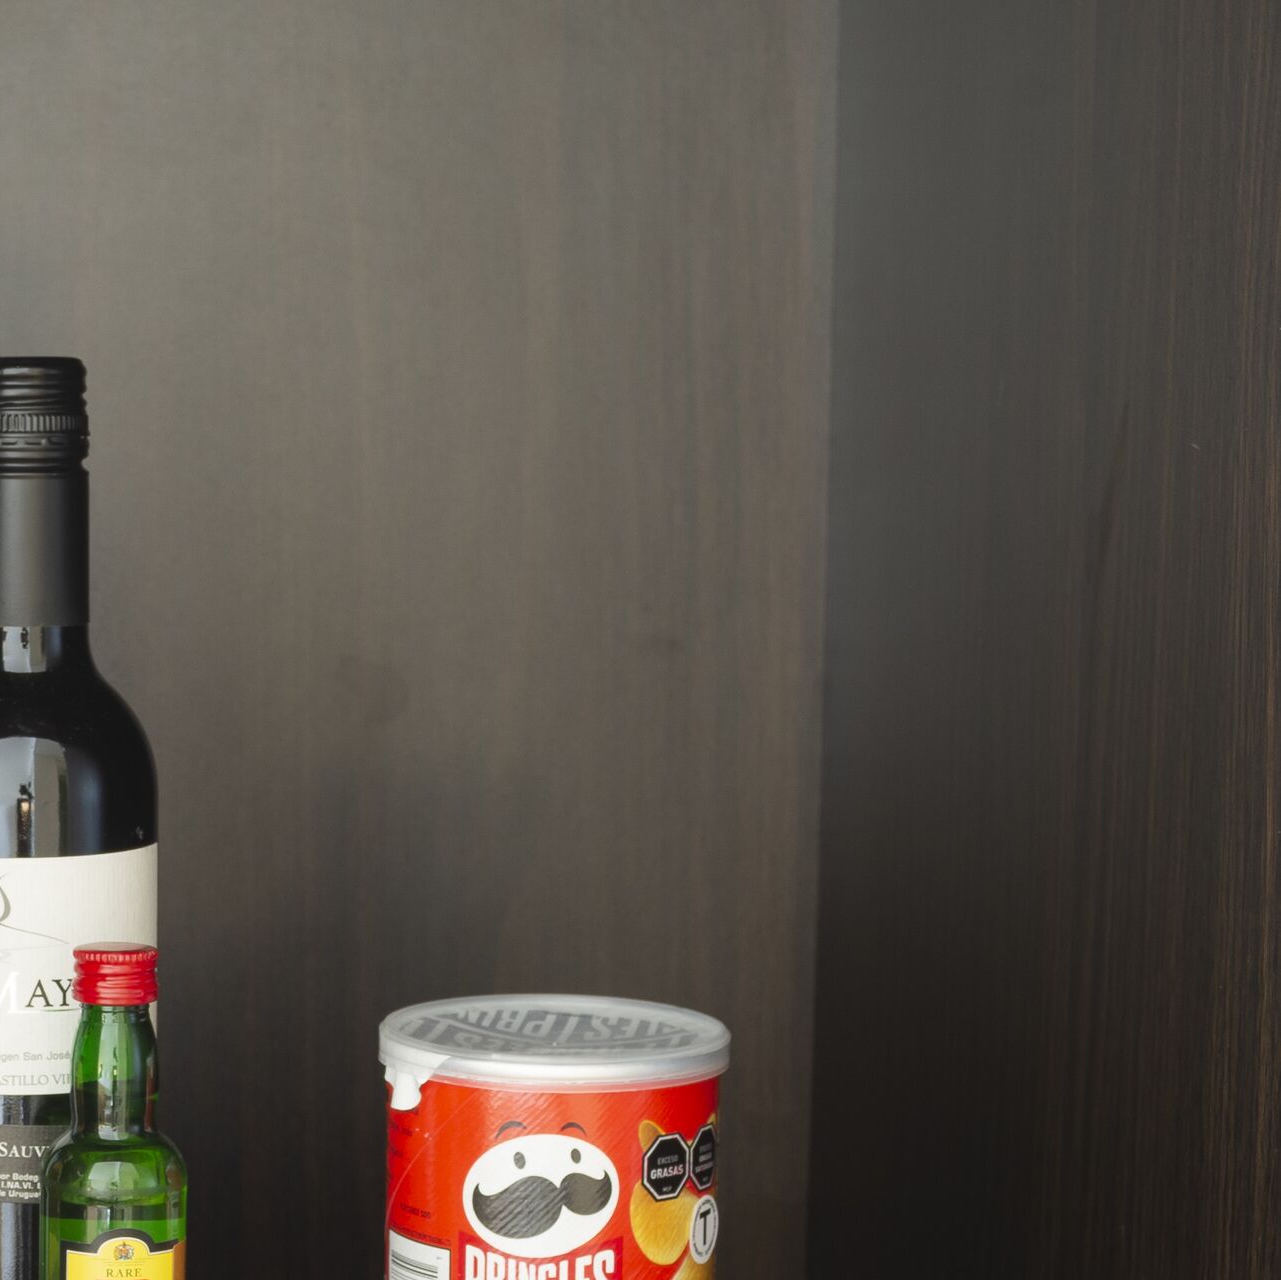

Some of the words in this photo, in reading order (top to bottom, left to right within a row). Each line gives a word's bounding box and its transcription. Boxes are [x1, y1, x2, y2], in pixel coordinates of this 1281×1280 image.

[23, 1052, 43, 1061] San
[650, 1164, 684, 1180] GRASAS
[106, 1268, 143, 1278] RARE
